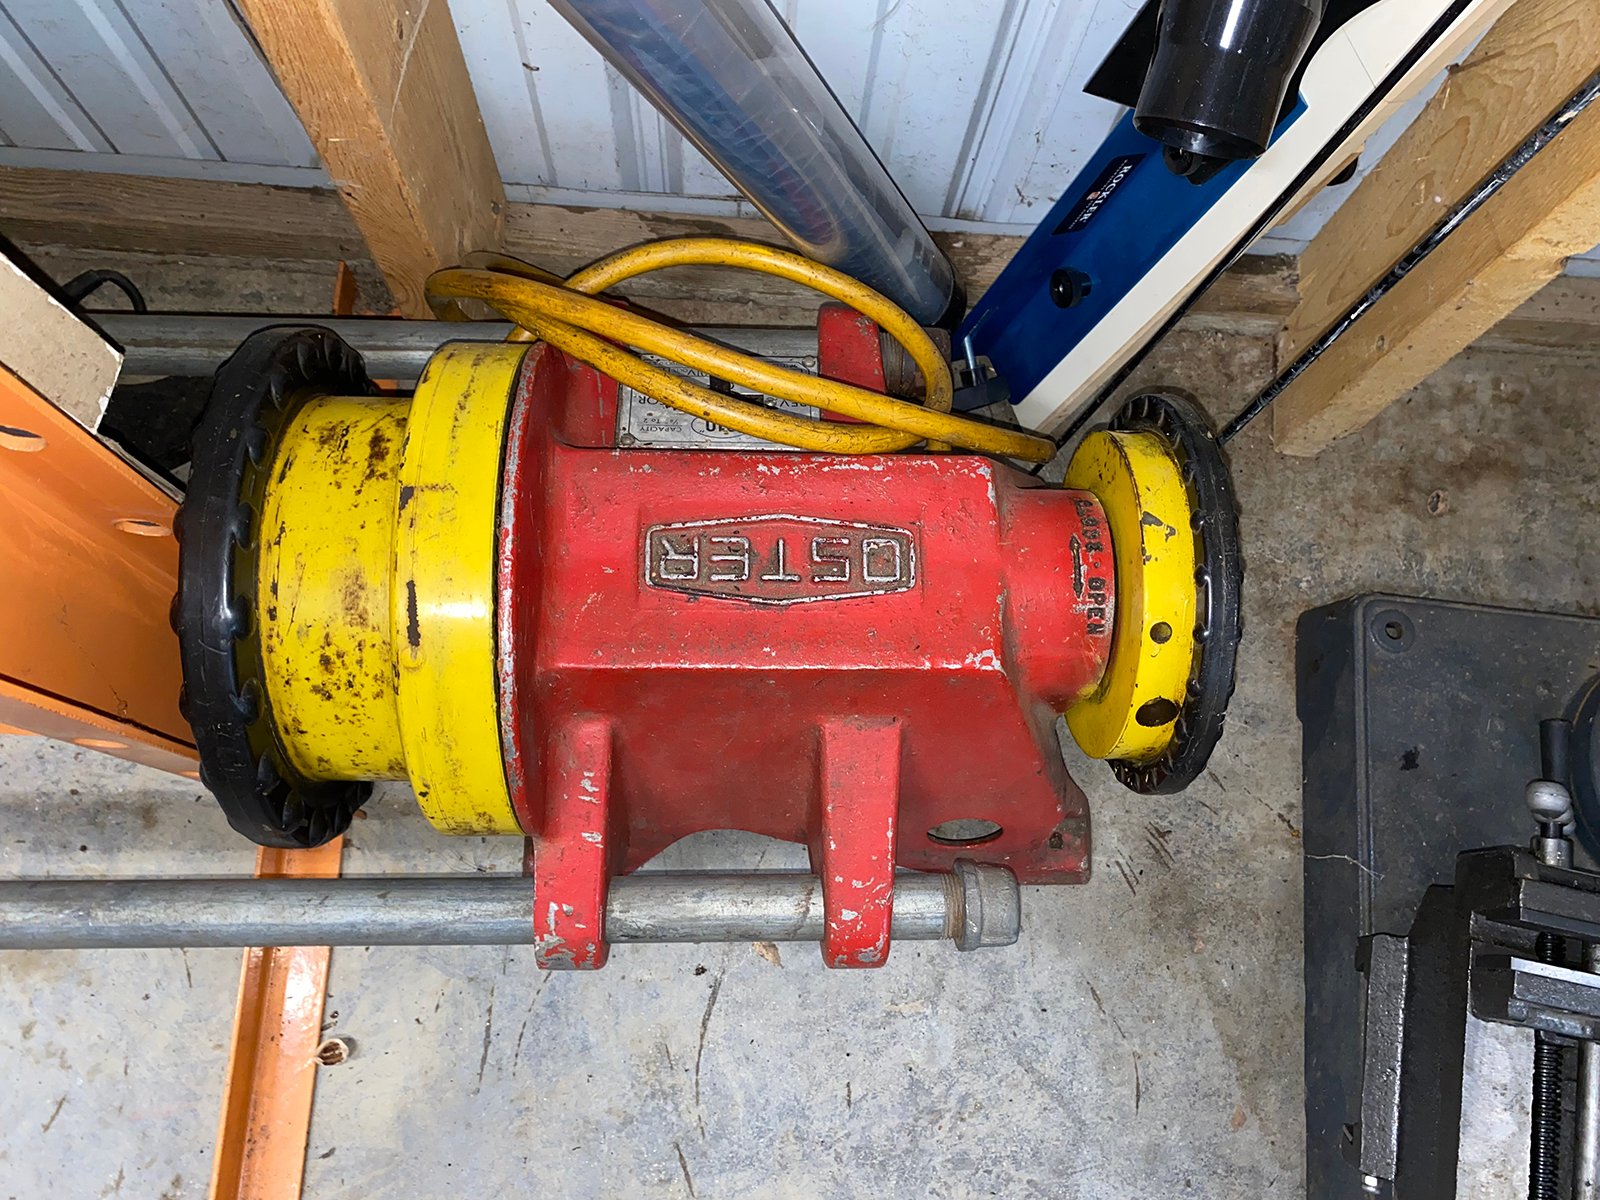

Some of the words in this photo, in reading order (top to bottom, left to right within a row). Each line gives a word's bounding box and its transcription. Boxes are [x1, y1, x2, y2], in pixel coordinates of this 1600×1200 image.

[1079, 164, 1133, 223] ROCKLER
[1074, 499, 1104, 553] CLOSE
[658, 536, 901, 584] OSTER
[1087, 577, 1107, 636] OPEN
